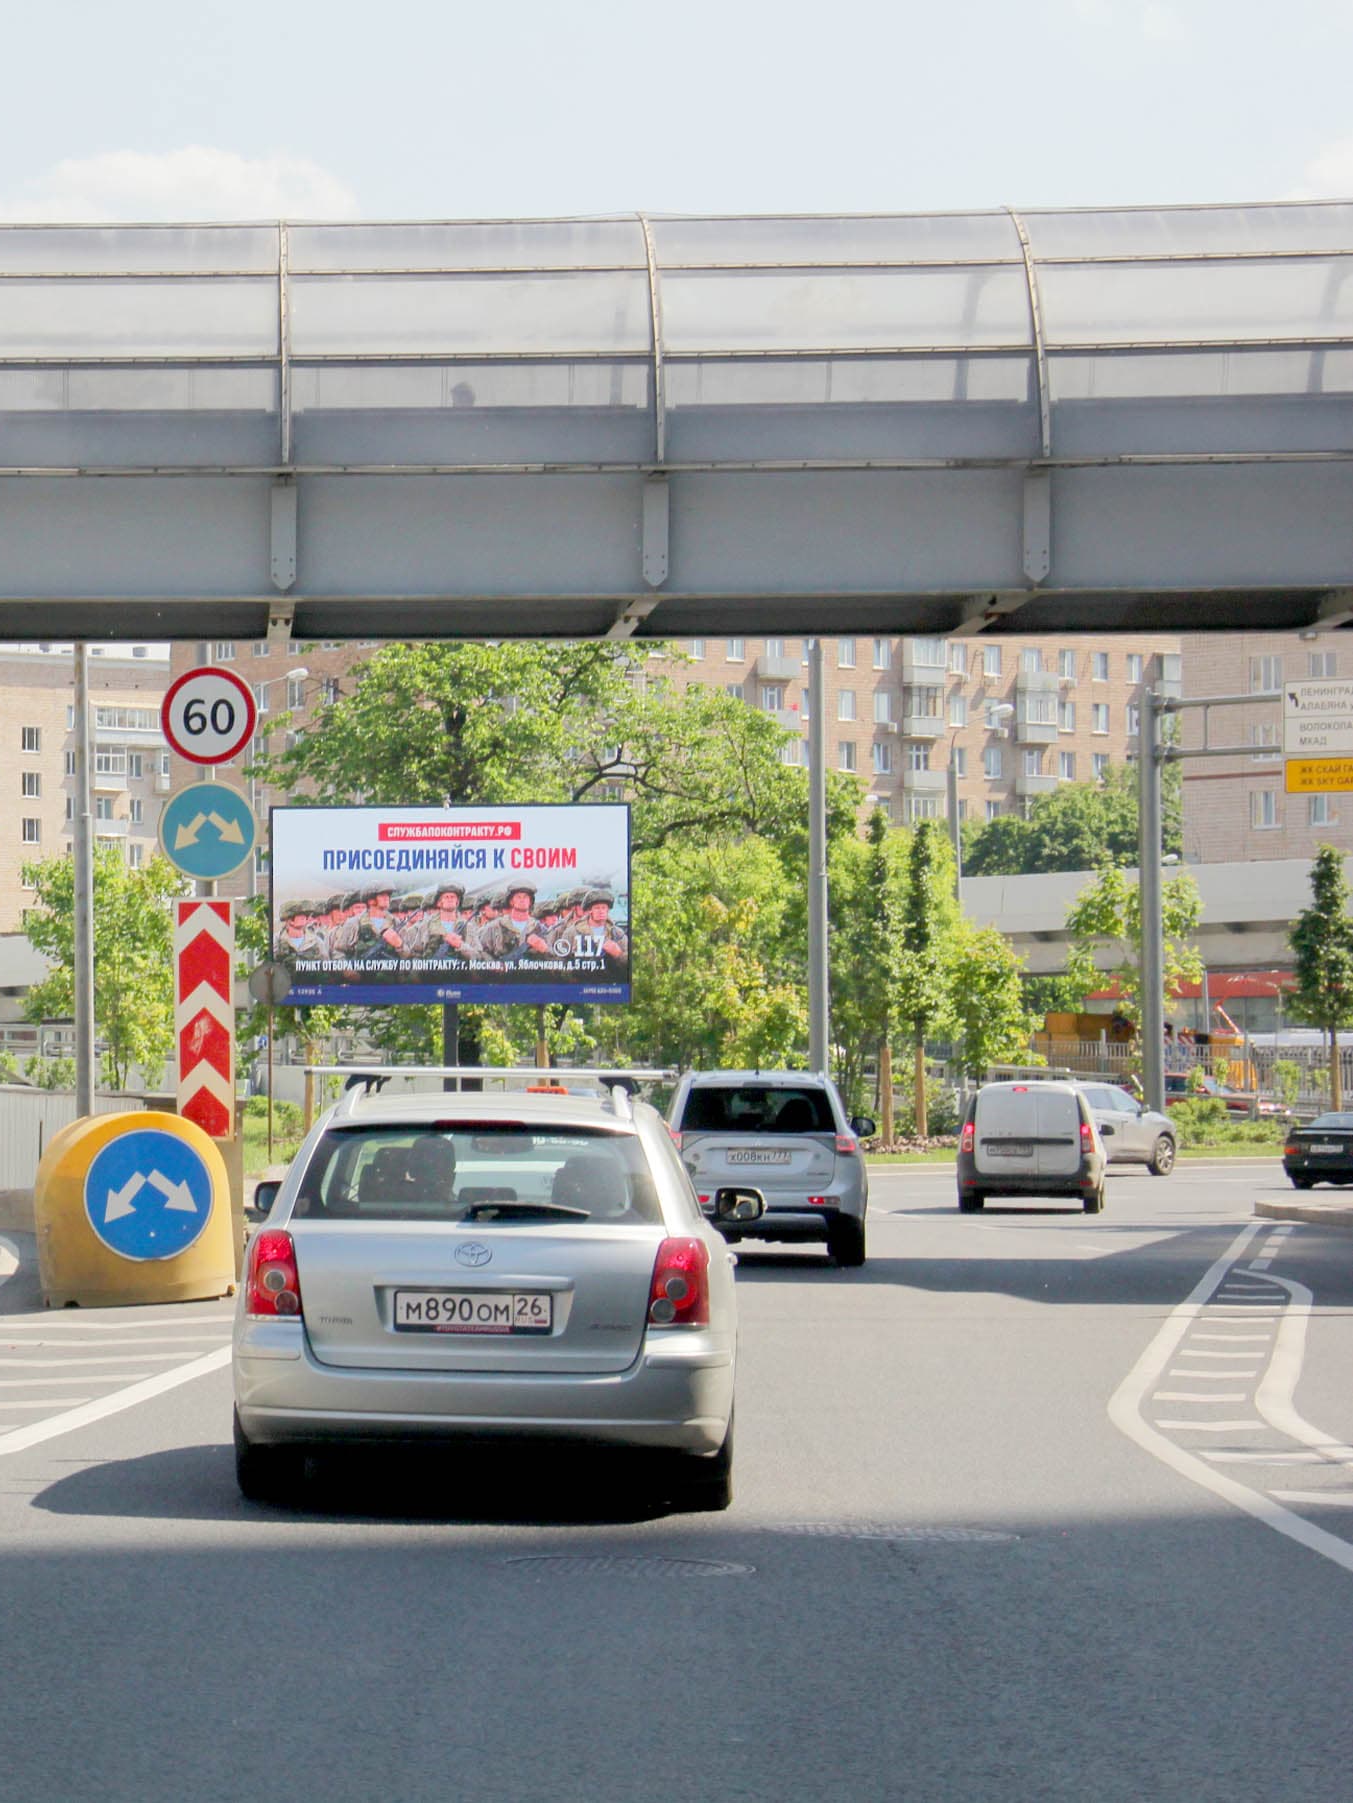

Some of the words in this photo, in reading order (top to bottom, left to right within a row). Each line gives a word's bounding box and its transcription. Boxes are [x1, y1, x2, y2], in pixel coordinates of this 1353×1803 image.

[1301, 687, 1353, 697] ЛЕНИНГРА
[183, 699, 235, 735] 60
[1299, 736, 1327, 746] МКАД
[387, 826, 512, 838] СЛУЖБАПОКОНТРАКТУ.РФ
[323, 844, 486, 872] ПРИСОЕДИНЯЙСЯ
[493, 849, 504, 869] К
[511, 848, 577, 869] СВОИМ
[574, 935, 605, 957] 117
[295, 960, 321, 971] ПУНКТ
[322, 960, 352, 971] ОТБОРА
[354, 960, 364, 971] НА
[366, 960, 398, 971] СЛУЖБУ
[399, 960, 411, 971] ПО
[412, 960, 459, 971] КОНТРАКТУ:
[505, 961, 516, 972] ул.
[582, 960, 600, 971] стр.
[601, 959, 606, 969] 1
[406, 1297, 510, 1322] М890ОМ
